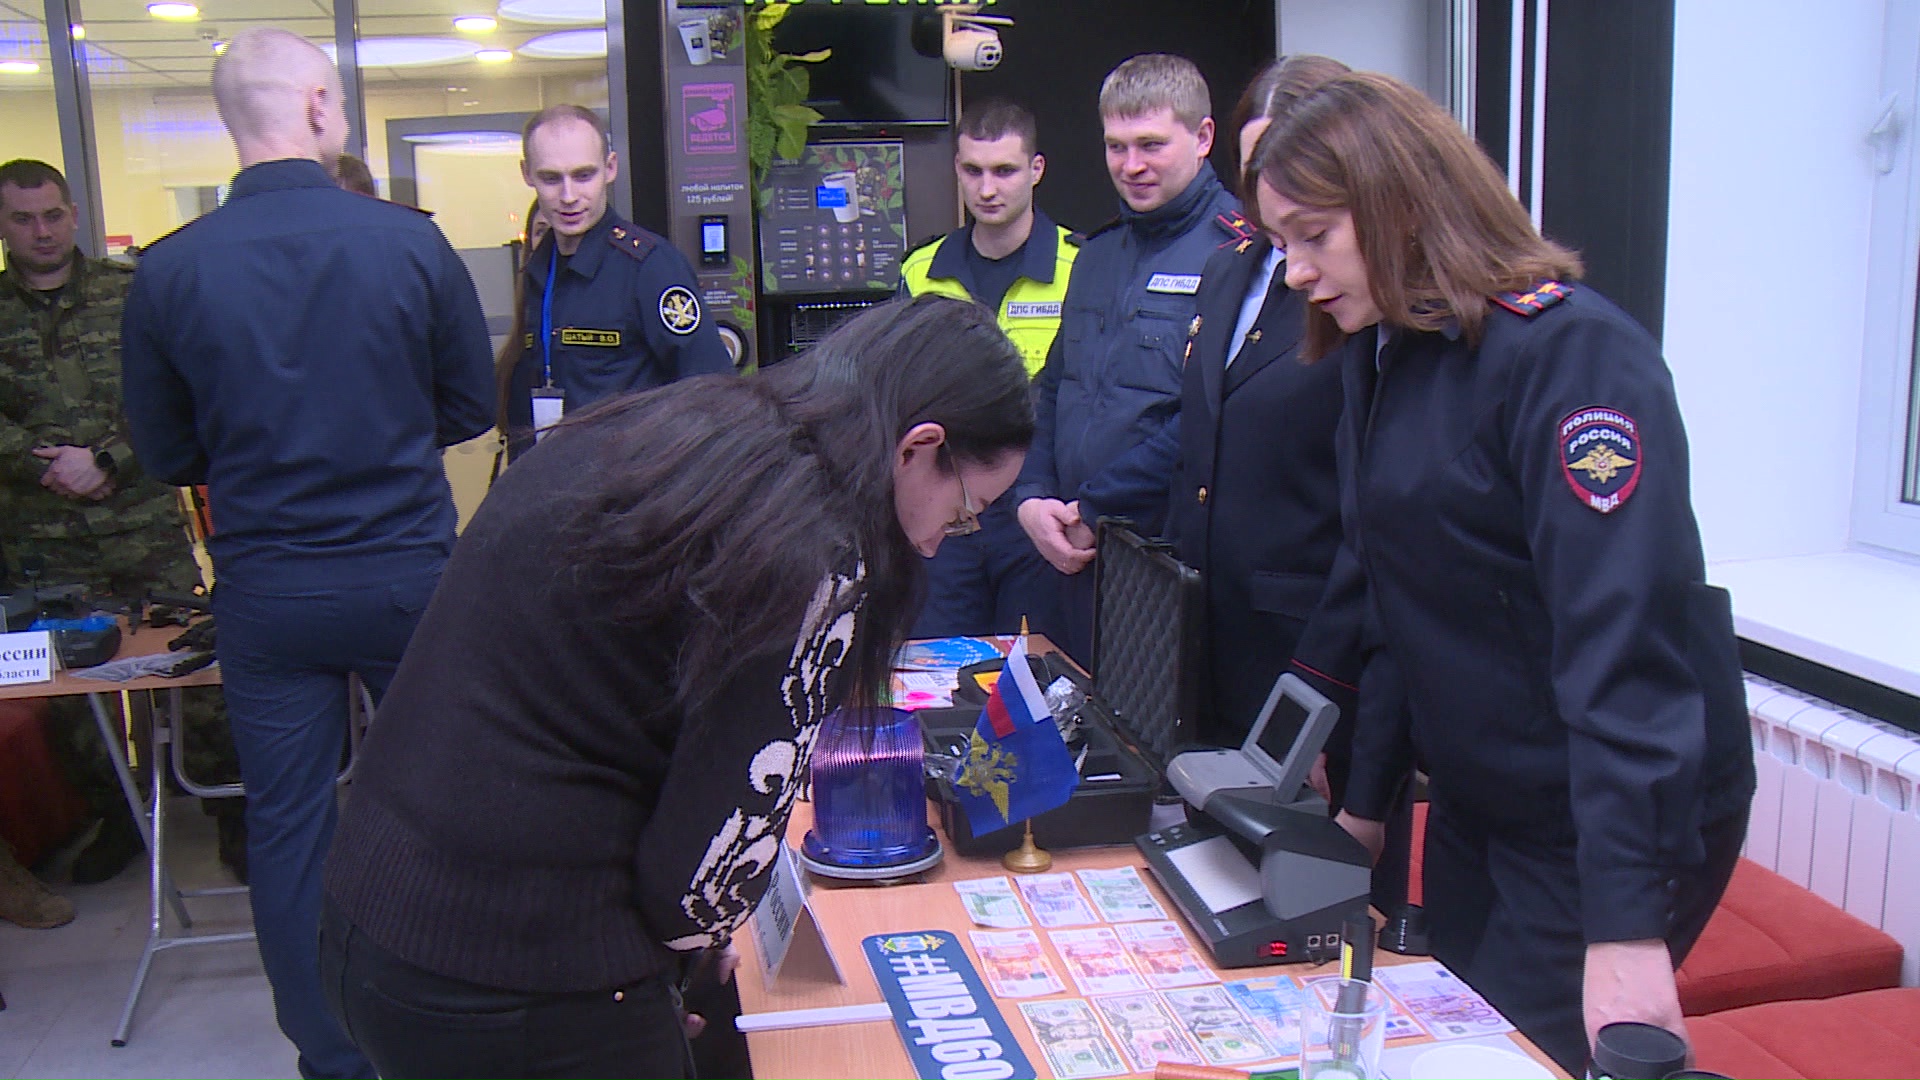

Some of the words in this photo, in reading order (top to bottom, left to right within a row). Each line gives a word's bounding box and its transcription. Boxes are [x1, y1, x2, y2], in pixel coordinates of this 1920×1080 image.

[681, 183, 709, 192] любой
[710, 183, 744, 191] напиток
[687, 195, 701, 203] 125
[1150, 278, 1170, 286] ДПС
[1170, 279, 1197, 288] ГИБДД
[1010, 305, 1029, 314] ДПС
[1030, 305, 1060, 314] ГИБДД
[1562, 412, 1634, 436] ПОЛИЦИЯ
[1569, 429, 1632, 454] РОССИЯ
[1590, 493, 1620, 513] МВД
[0, 648, 47, 661] ссии
[888, 953, 1015, 1080] #МВД60
